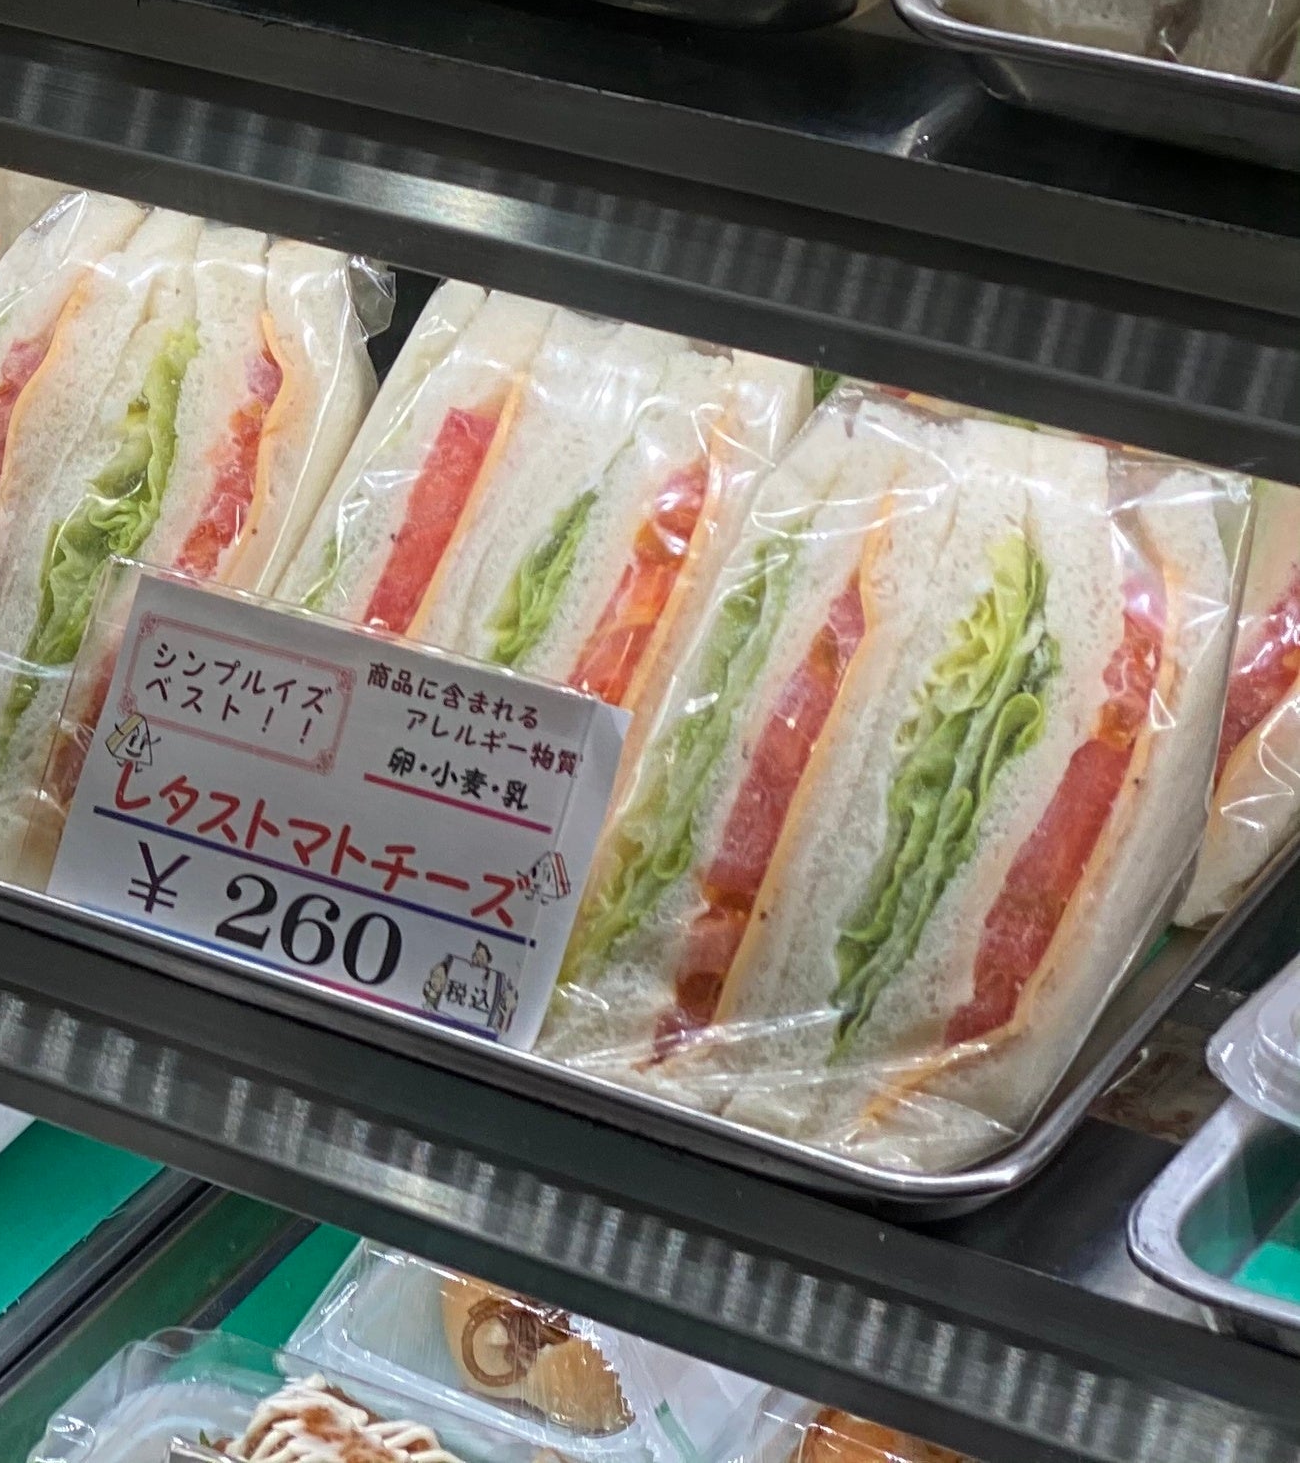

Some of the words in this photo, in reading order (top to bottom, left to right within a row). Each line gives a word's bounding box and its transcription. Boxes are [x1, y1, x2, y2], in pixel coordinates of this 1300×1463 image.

[152, 642, 333, 715] シンプルイズ
[367, 662, 540, 730] 商品に含まれる
[406, 709, 579, 778] アレルギー物質
[387, 746, 530, 812] 卵・小麦・乳
[114, 761, 532, 929] レタストマトチーズ
[445, 979, 491, 1011] 税込
